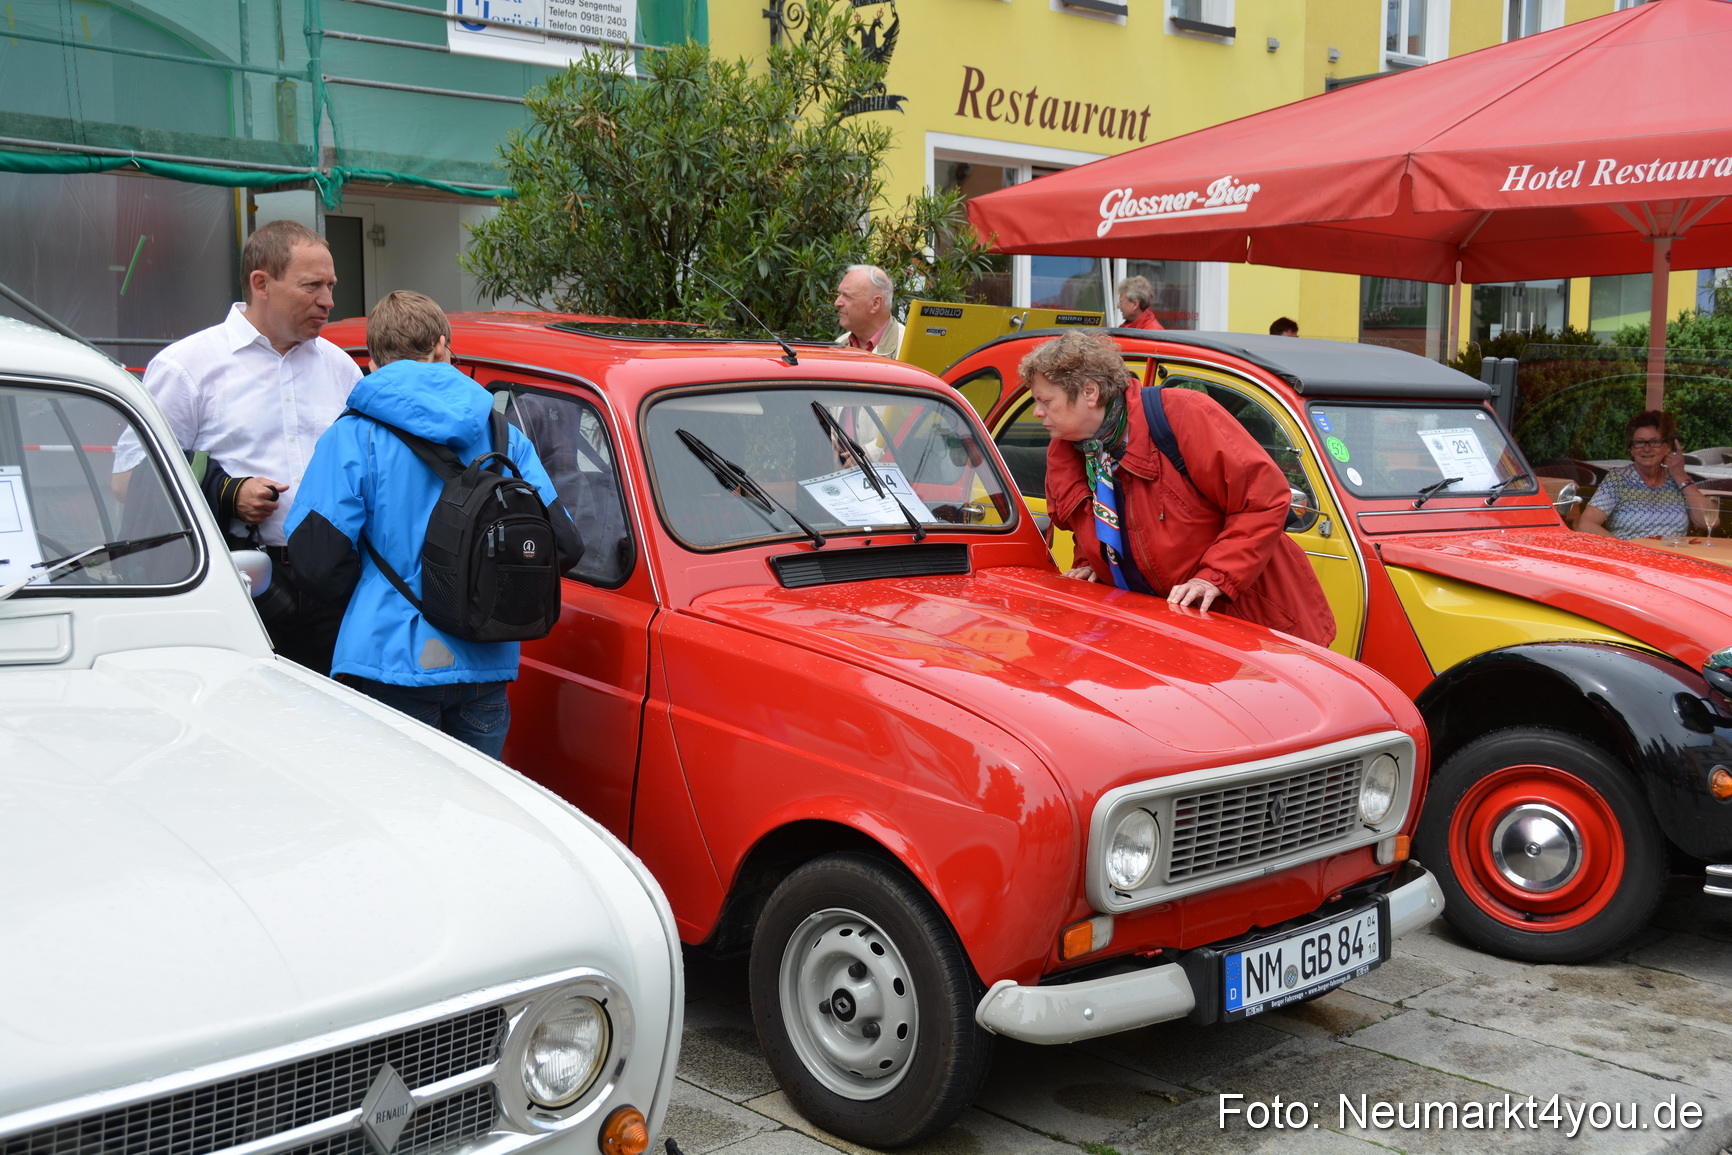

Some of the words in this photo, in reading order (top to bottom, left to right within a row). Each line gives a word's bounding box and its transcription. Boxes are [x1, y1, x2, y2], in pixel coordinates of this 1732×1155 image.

[578, 0, 622, 13] Sengenthal
[549, 6, 578, 19] Telefon
[580, 11, 627, 27] 09181/2403
[548, 19, 577, 32] Telefon
[580, 24, 628, 40] 09181/8680
[954, 65, 1151, 143] Restaurant
[1499, 160, 1586, 192] Hotel
[1588, 155, 1732, 187] Restaura
[1096, 175, 1261, 238] Glossner-Bier
[1331, 442, 1346, 456] 52
[1452, 439, 1474, 454] 291
[1367, 914, 1376, 927] 04
[1368, 942, 1377, 955] 10
[1246, 948, 1282, 998] NM
[1301, 932, 1332, 980] GB
[1338, 919, 1364, 966] 84
[1230, 988, 1237, 1000] D
[1271, 996, 1285, 1008] Berger
[1284, 991, 1304, 1004] Fahrzeuge
[376, 1102, 409, 1125] RENAULT
